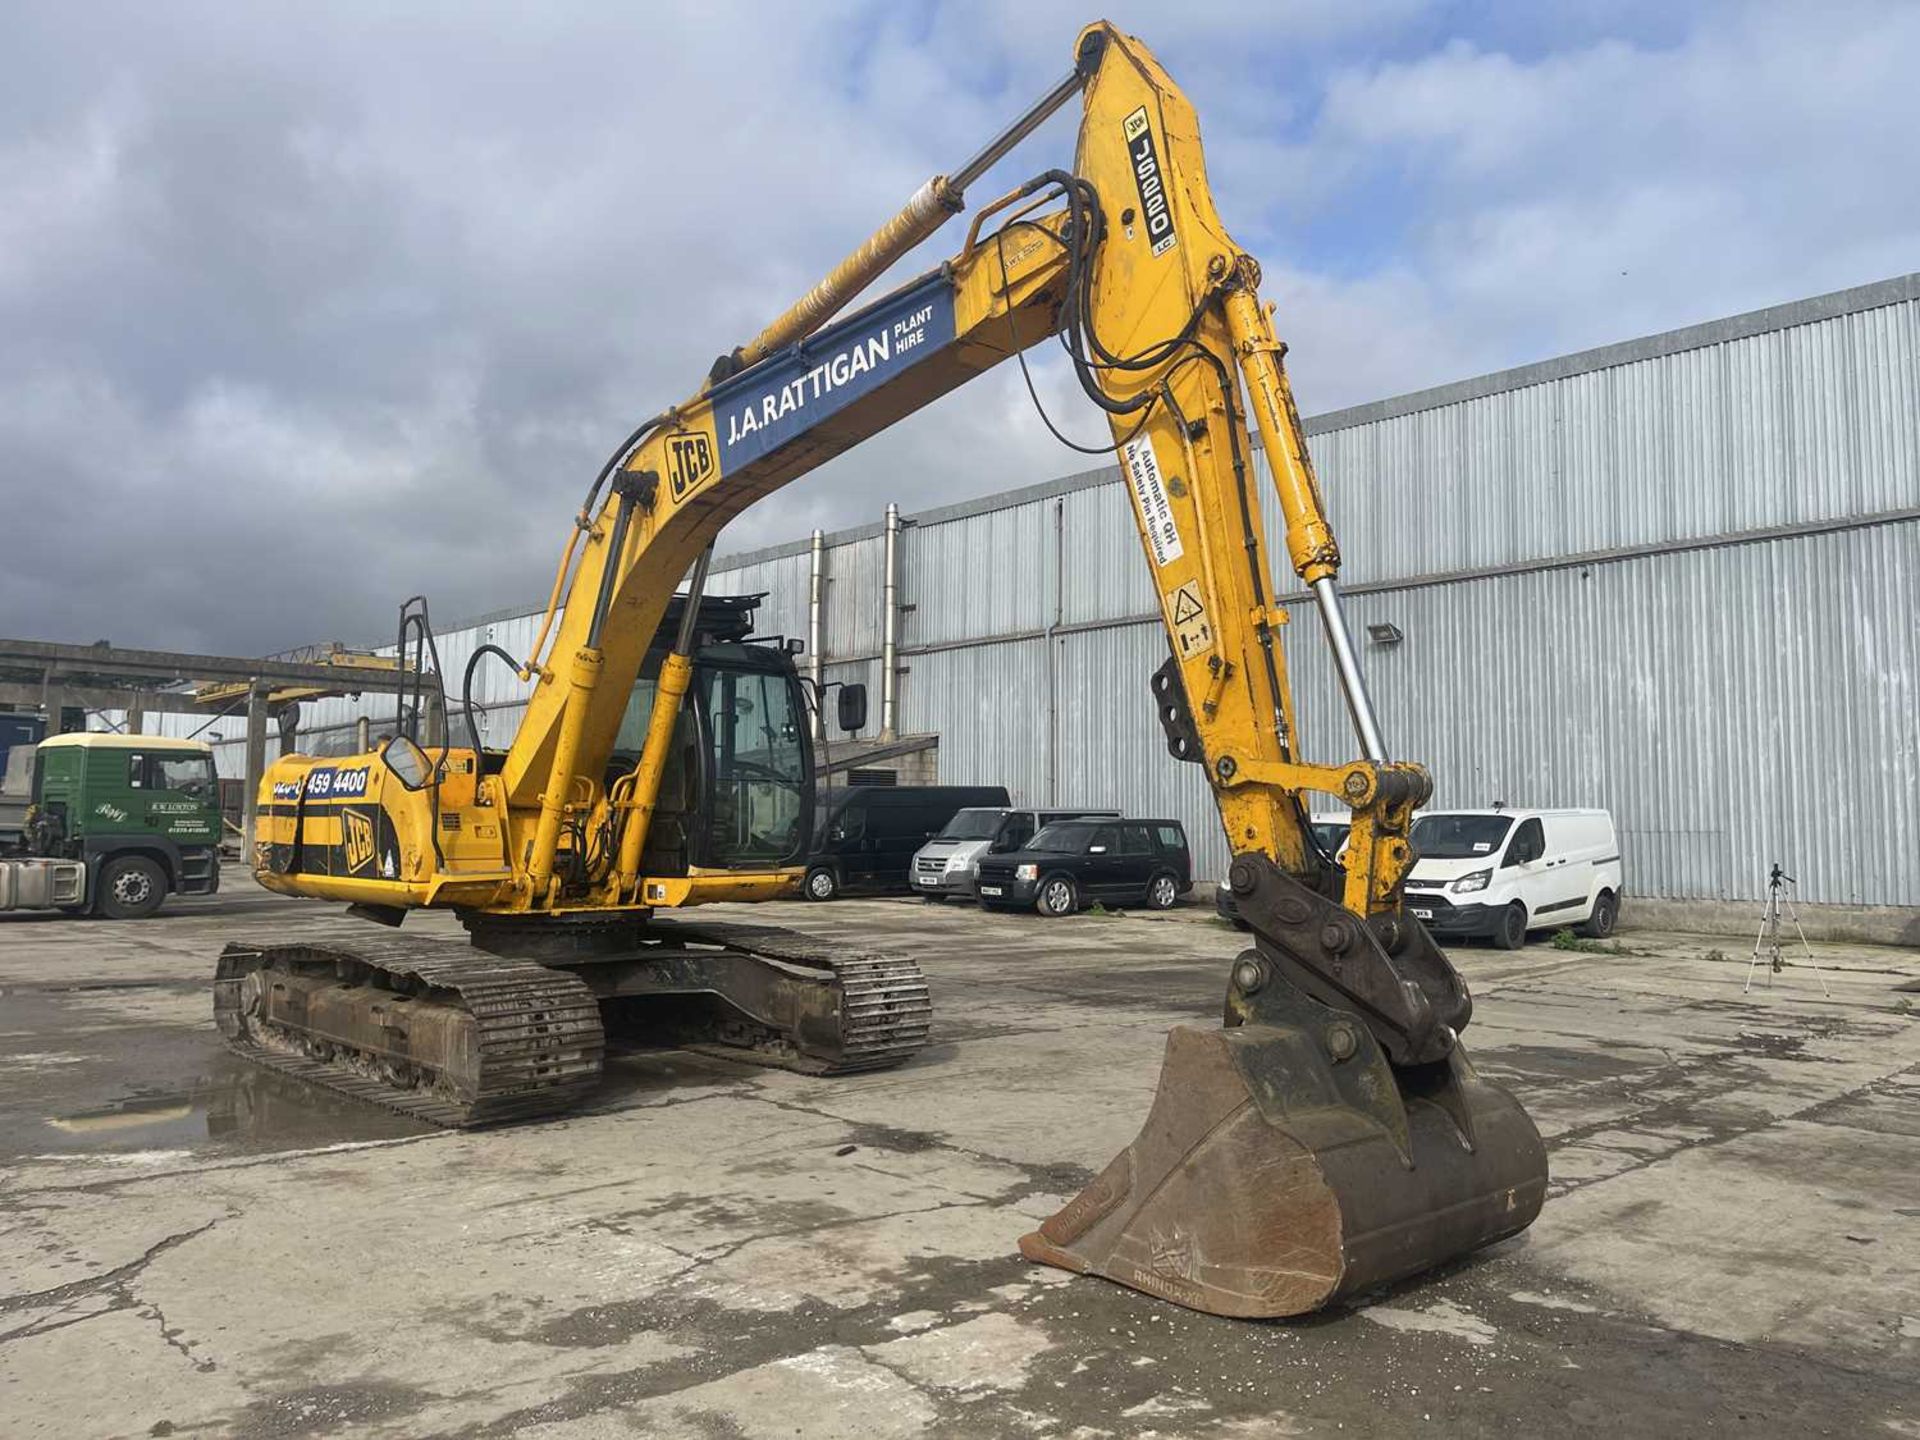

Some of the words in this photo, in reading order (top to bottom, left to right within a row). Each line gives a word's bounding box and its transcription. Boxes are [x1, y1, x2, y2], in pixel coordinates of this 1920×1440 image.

[1136, 138, 1169, 235] JS220
[894, 305, 934, 338] PLANT
[895, 331, 925, 355] HIRE
[671, 438, 710, 496] JCB
[1127, 444, 1136, 461] No
[1131, 462, 1146, 496] Safety
[1141, 449, 1168, 520] Automatic
[1163, 521, 1178, 546] QH
[1141, 497, 1152, 516] Pin
[1147, 516, 1168, 564] Required
[307, 773, 331, 794] 459
[333, 771, 367, 792] 4400
[347, 814, 373, 867] JCB
